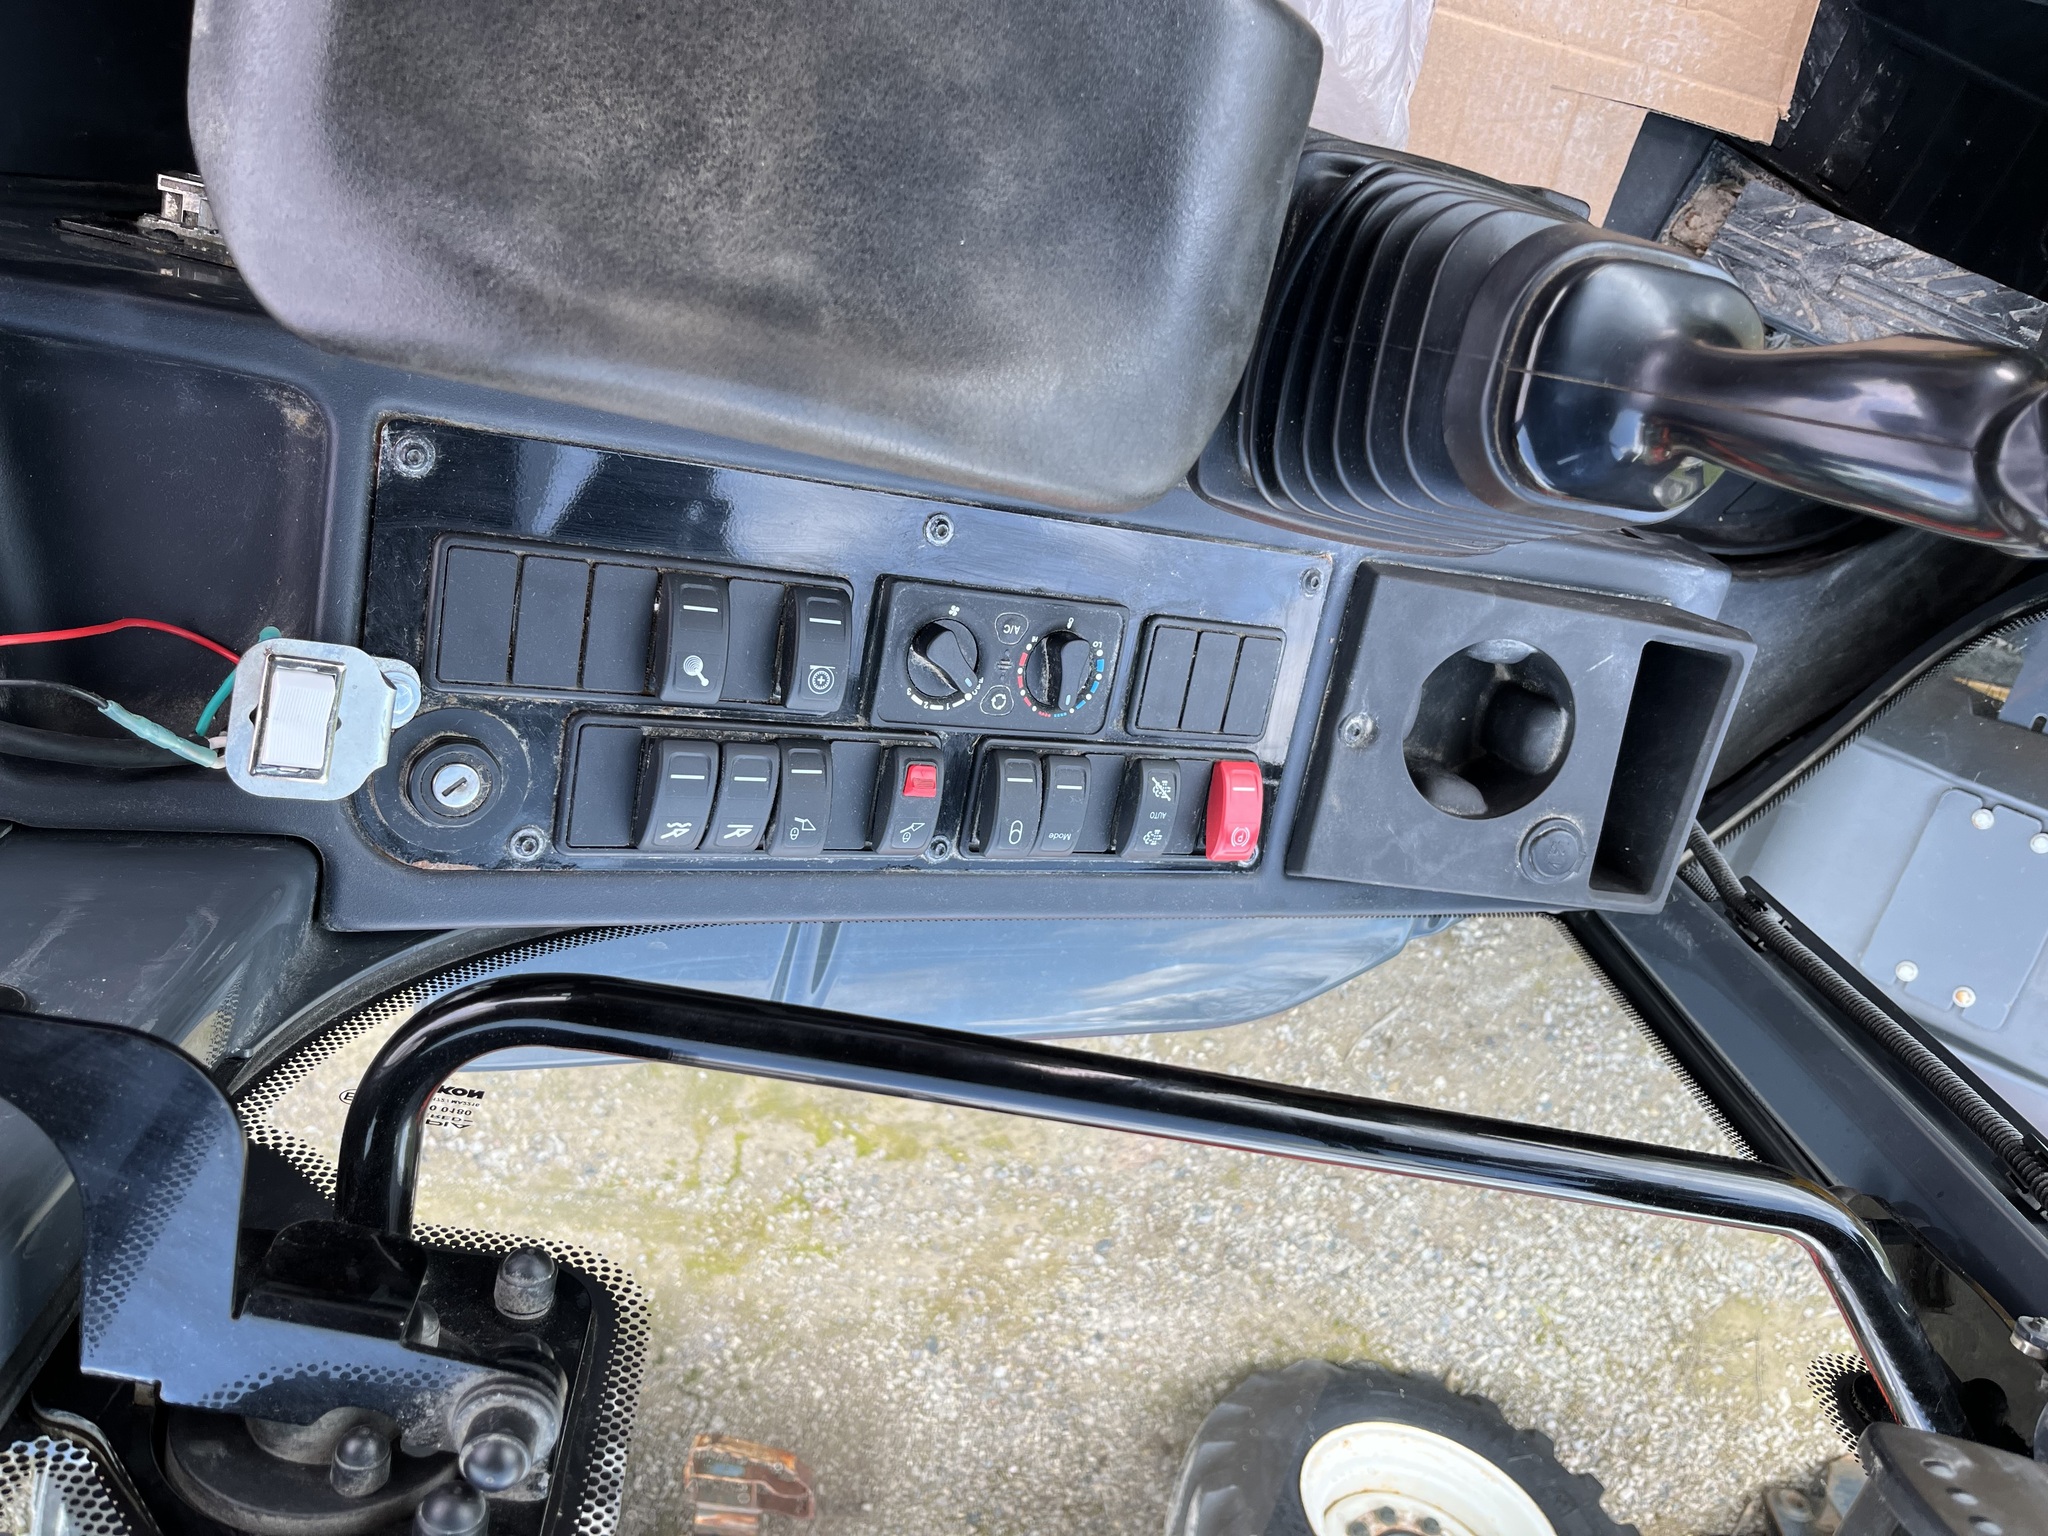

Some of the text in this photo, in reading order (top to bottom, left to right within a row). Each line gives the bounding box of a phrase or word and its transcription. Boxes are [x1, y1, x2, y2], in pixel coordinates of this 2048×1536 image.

[1002, 624, 1021, 635] A/C
[1092, 640, 1103, 648] LO
[1149, 811, 1167, 819] AUTO
[1048, 832, 1072, 841] Mode
